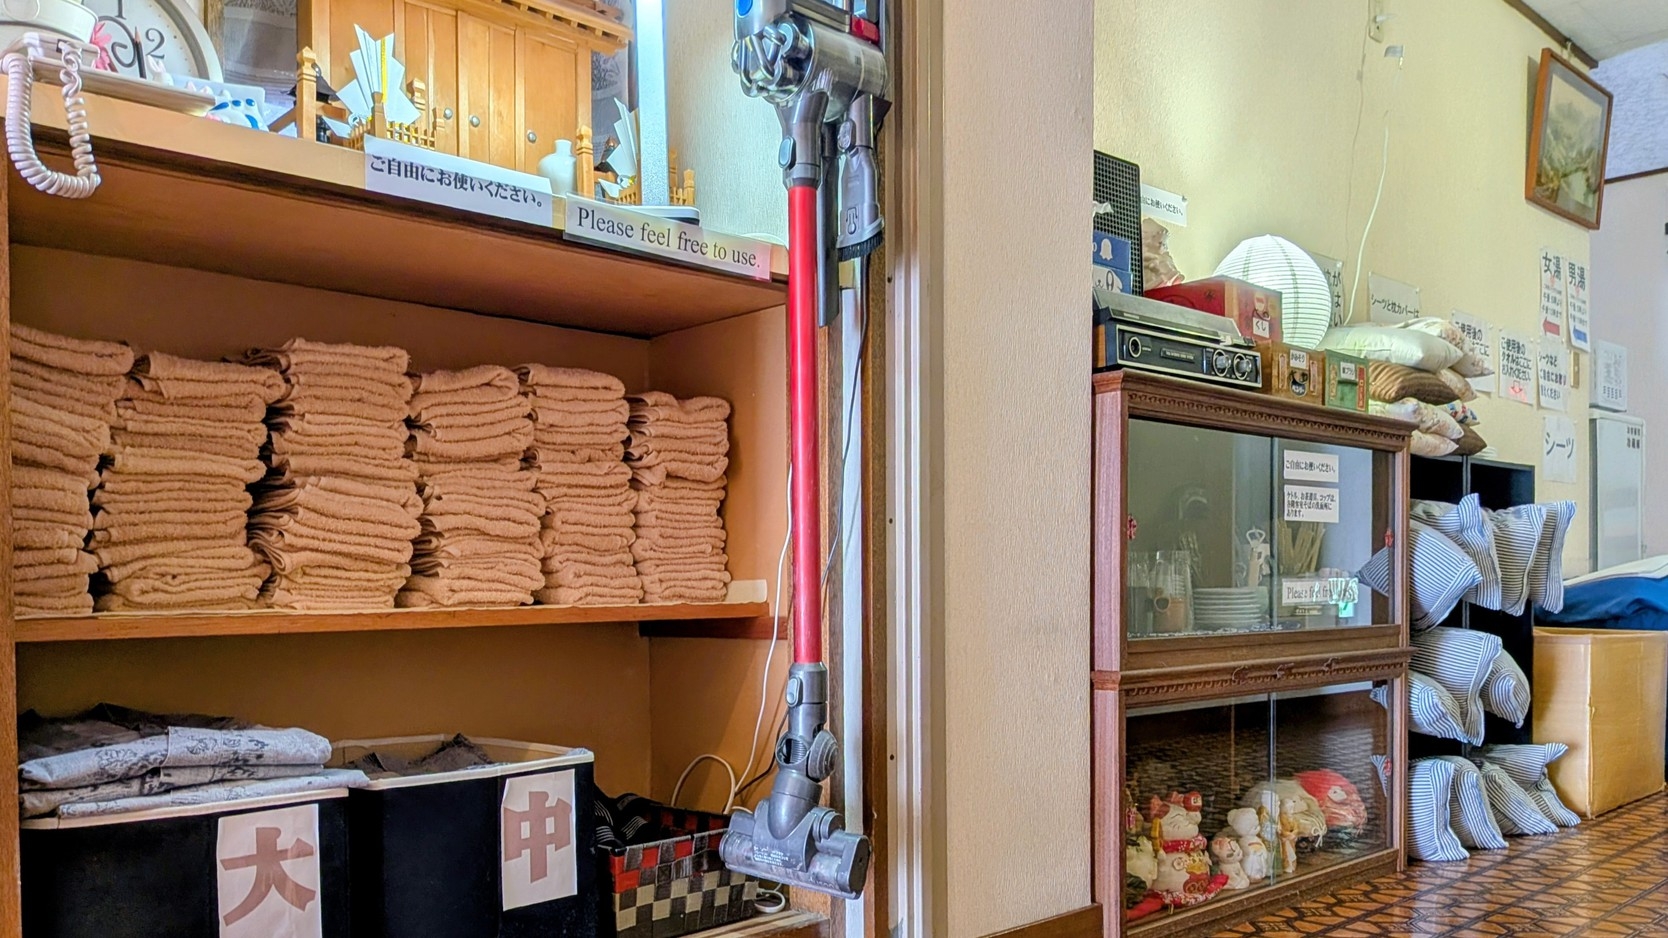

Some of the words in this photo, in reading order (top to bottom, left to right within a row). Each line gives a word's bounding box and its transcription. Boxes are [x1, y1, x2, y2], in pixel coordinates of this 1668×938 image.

[145, 28, 165, 60] 2
[370, 154, 543, 208] ご自由にお使いください。
[577, 206, 634, 238] Please
[640, 222, 670, 248] feel
[677, 231, 708, 256] free
[713, 242, 727, 260] to
[732, 249, 760, 268] use.
[1542, 251, 1561, 281] 女湯
[1568, 261, 1586, 292] 男湯
[1545, 431, 1575, 459] シーツ
[503, 790, 573, 884] 中
[219, 826, 317, 927] 大
